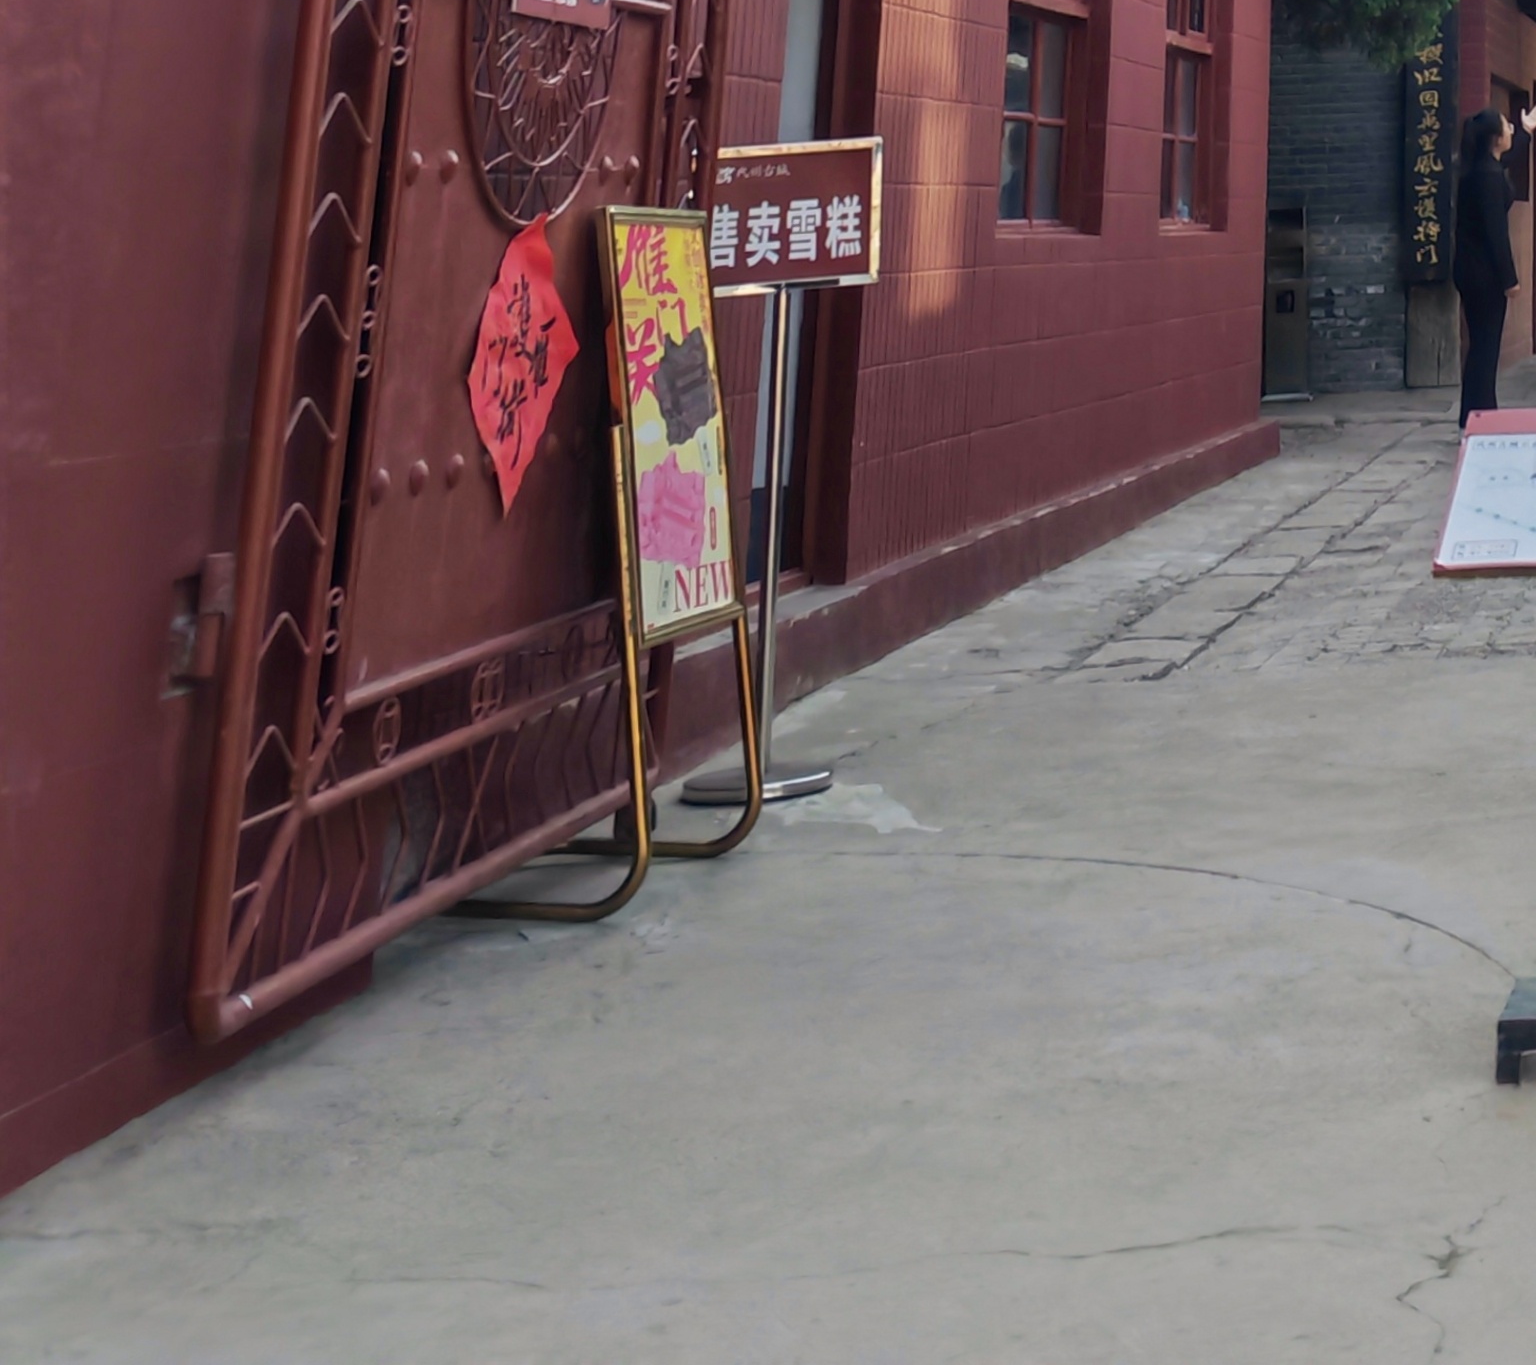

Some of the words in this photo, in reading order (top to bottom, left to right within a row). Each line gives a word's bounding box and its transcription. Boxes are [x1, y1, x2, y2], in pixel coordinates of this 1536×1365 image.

[710, 194, 863, 270] 售卖雪糕
[673, 560, 730, 613] NEW
